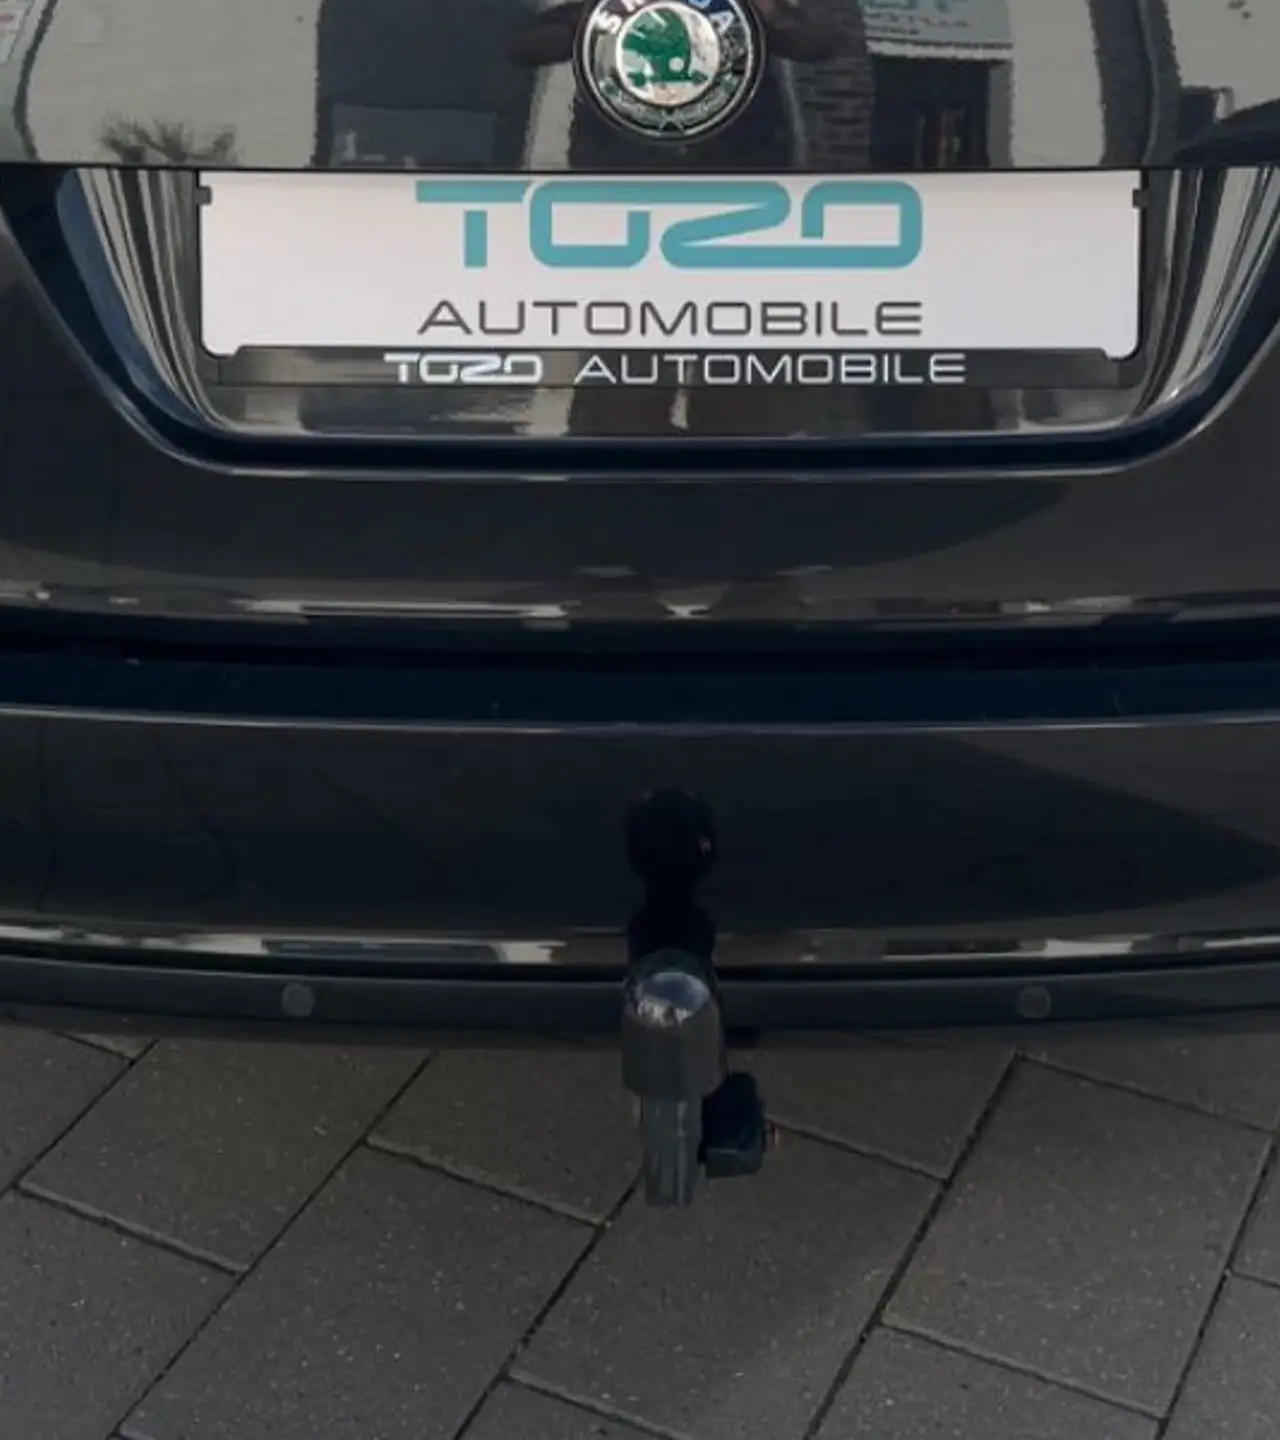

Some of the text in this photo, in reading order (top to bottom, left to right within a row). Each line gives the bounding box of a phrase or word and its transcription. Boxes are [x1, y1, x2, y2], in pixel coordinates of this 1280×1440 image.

[415, 179, 923, 269] TOZO
[417, 300, 924, 336] AUTOMOBILE
[383, 353, 968, 385] TOZO AUTOMOBILE
